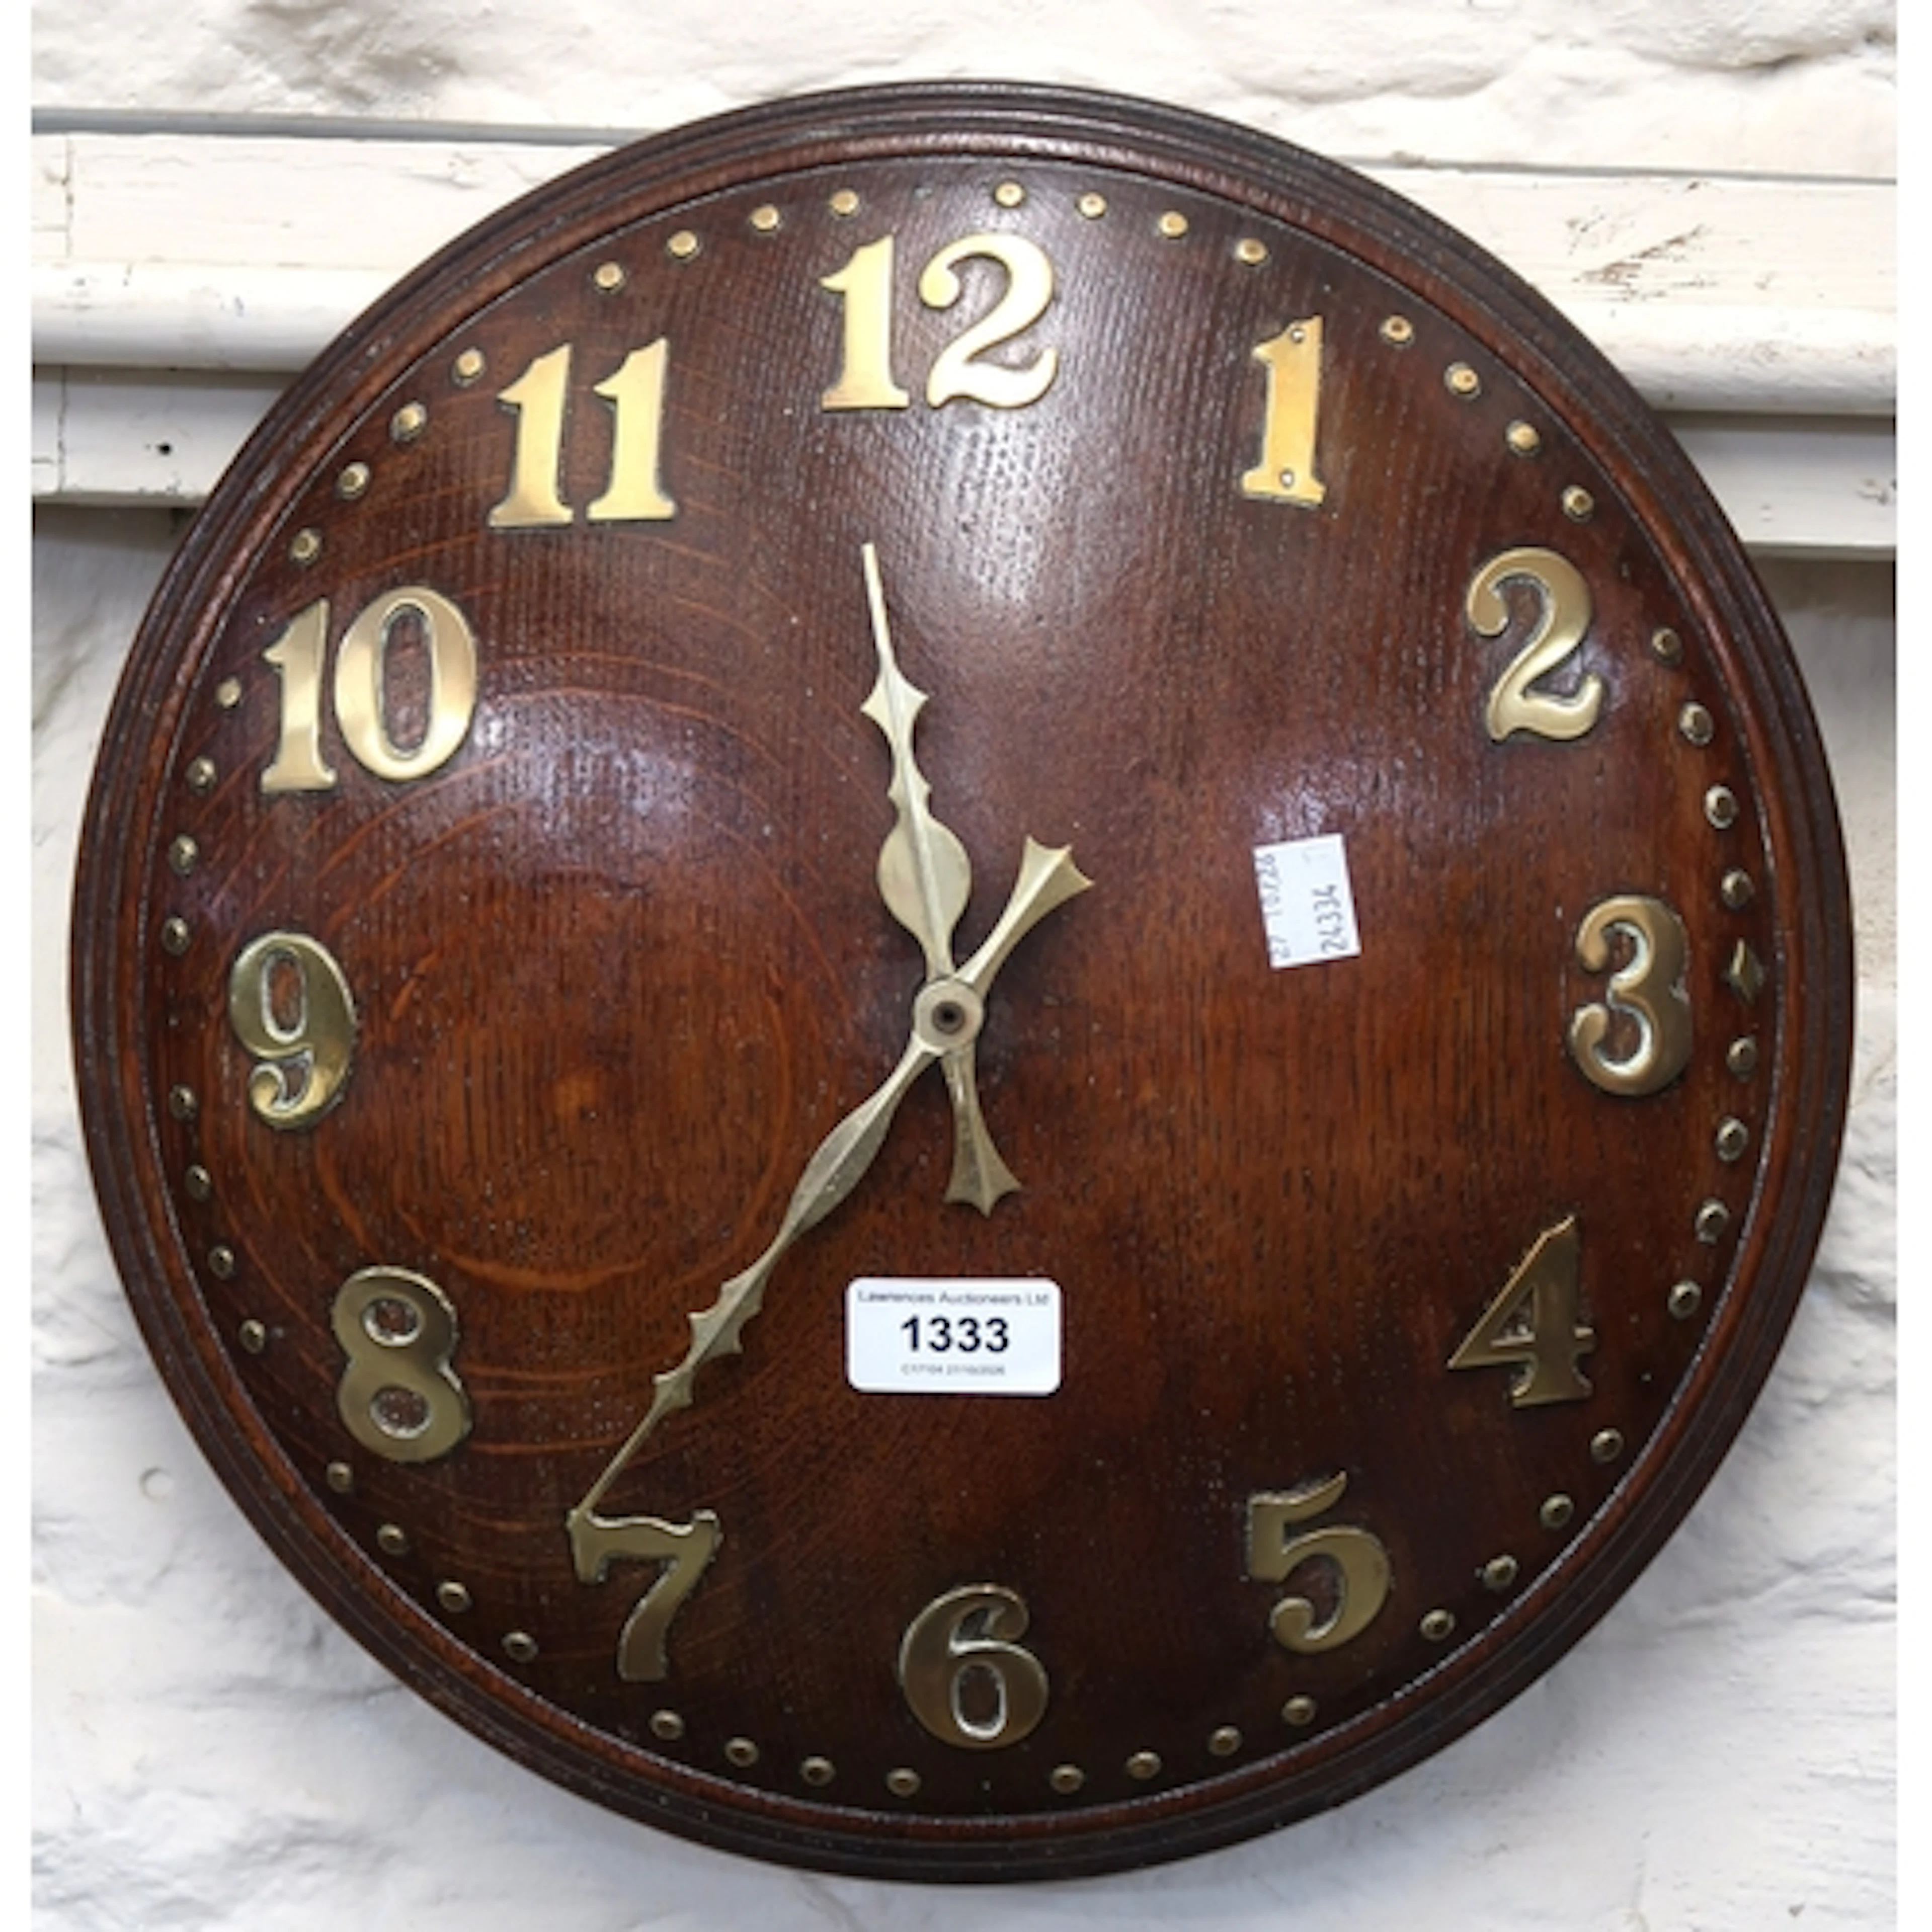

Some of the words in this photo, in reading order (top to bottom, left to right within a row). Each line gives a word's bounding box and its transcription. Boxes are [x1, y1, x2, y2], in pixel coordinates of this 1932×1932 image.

[820, 232, 1059, 413] 12
[1241, 315, 1324, 505] 1
[488, 338, 676, 527] 11
[260, 586, 477, 793] 10
[1466, 546, 1605, 743] 2
[228, 932, 358, 1130] 9
[1568, 895, 1696, 1097] 3
[332, 1265, 473, 1463] 8
[857, 1290, 935, 1304] Lawrences
[939, 1291, 1022, 1305] Auctioneers
[1026, 1292, 1050, 1306] Ltd
[901, 1315, 1010, 1353] 1333
[1447, 1215, 1596, 1407] 4
[567, 1508, 722, 1682] 7
[1247, 1470, 1392, 1653] 5
[899, 1583, 1050, 1749] 6
